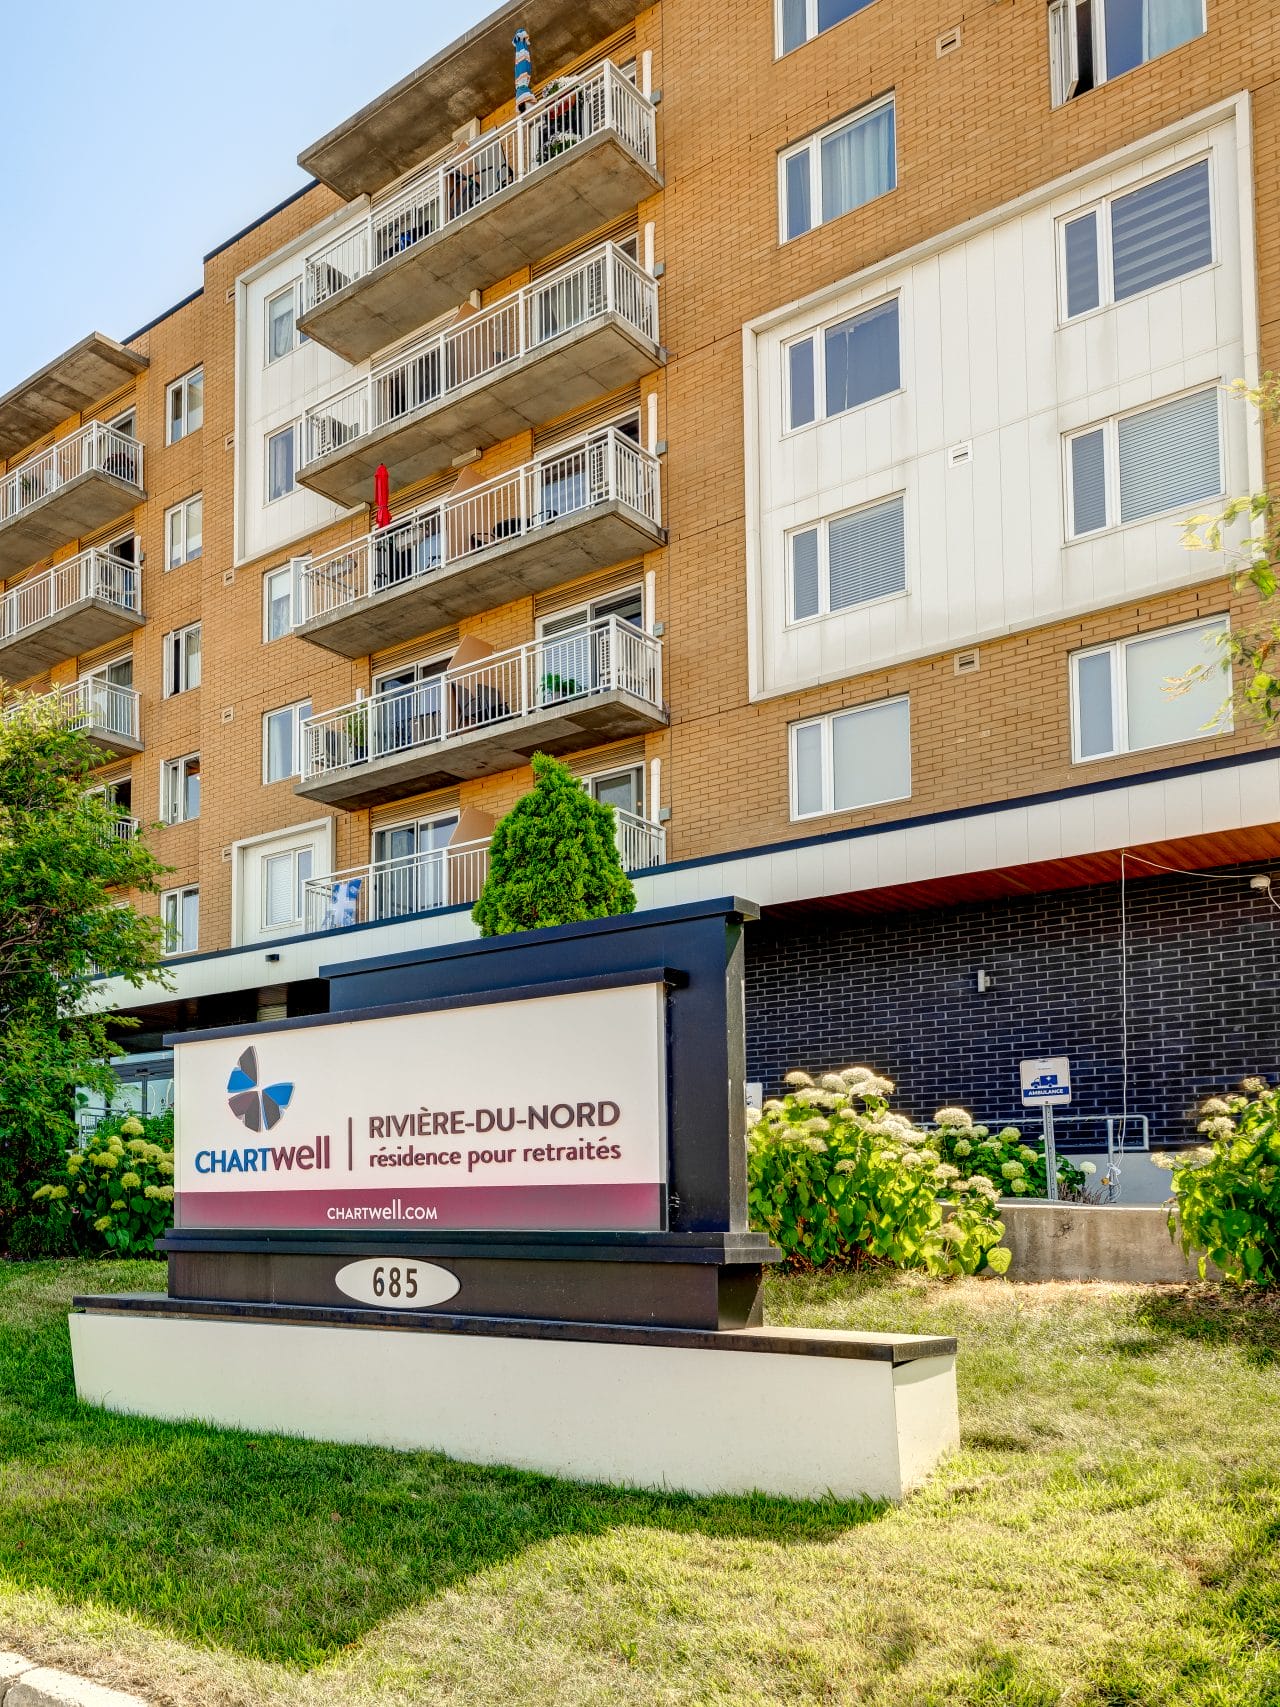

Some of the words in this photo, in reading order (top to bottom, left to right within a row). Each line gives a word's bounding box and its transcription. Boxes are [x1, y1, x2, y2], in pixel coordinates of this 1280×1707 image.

[1028, 1088, 1064, 1096] AMBULANCE
[369, 1100, 621, 1139] RIVIÈRE-DU-NORD
[194, 1135, 330, 1174] CHARTwell
[369, 1145, 462, 1168] résidence
[467, 1148, 517, 1173] pour
[523, 1136, 622, 1162] retraités
[326, 1198, 438, 1221] CHARTwell.COM
[372, 1266, 418, 1298] 685
